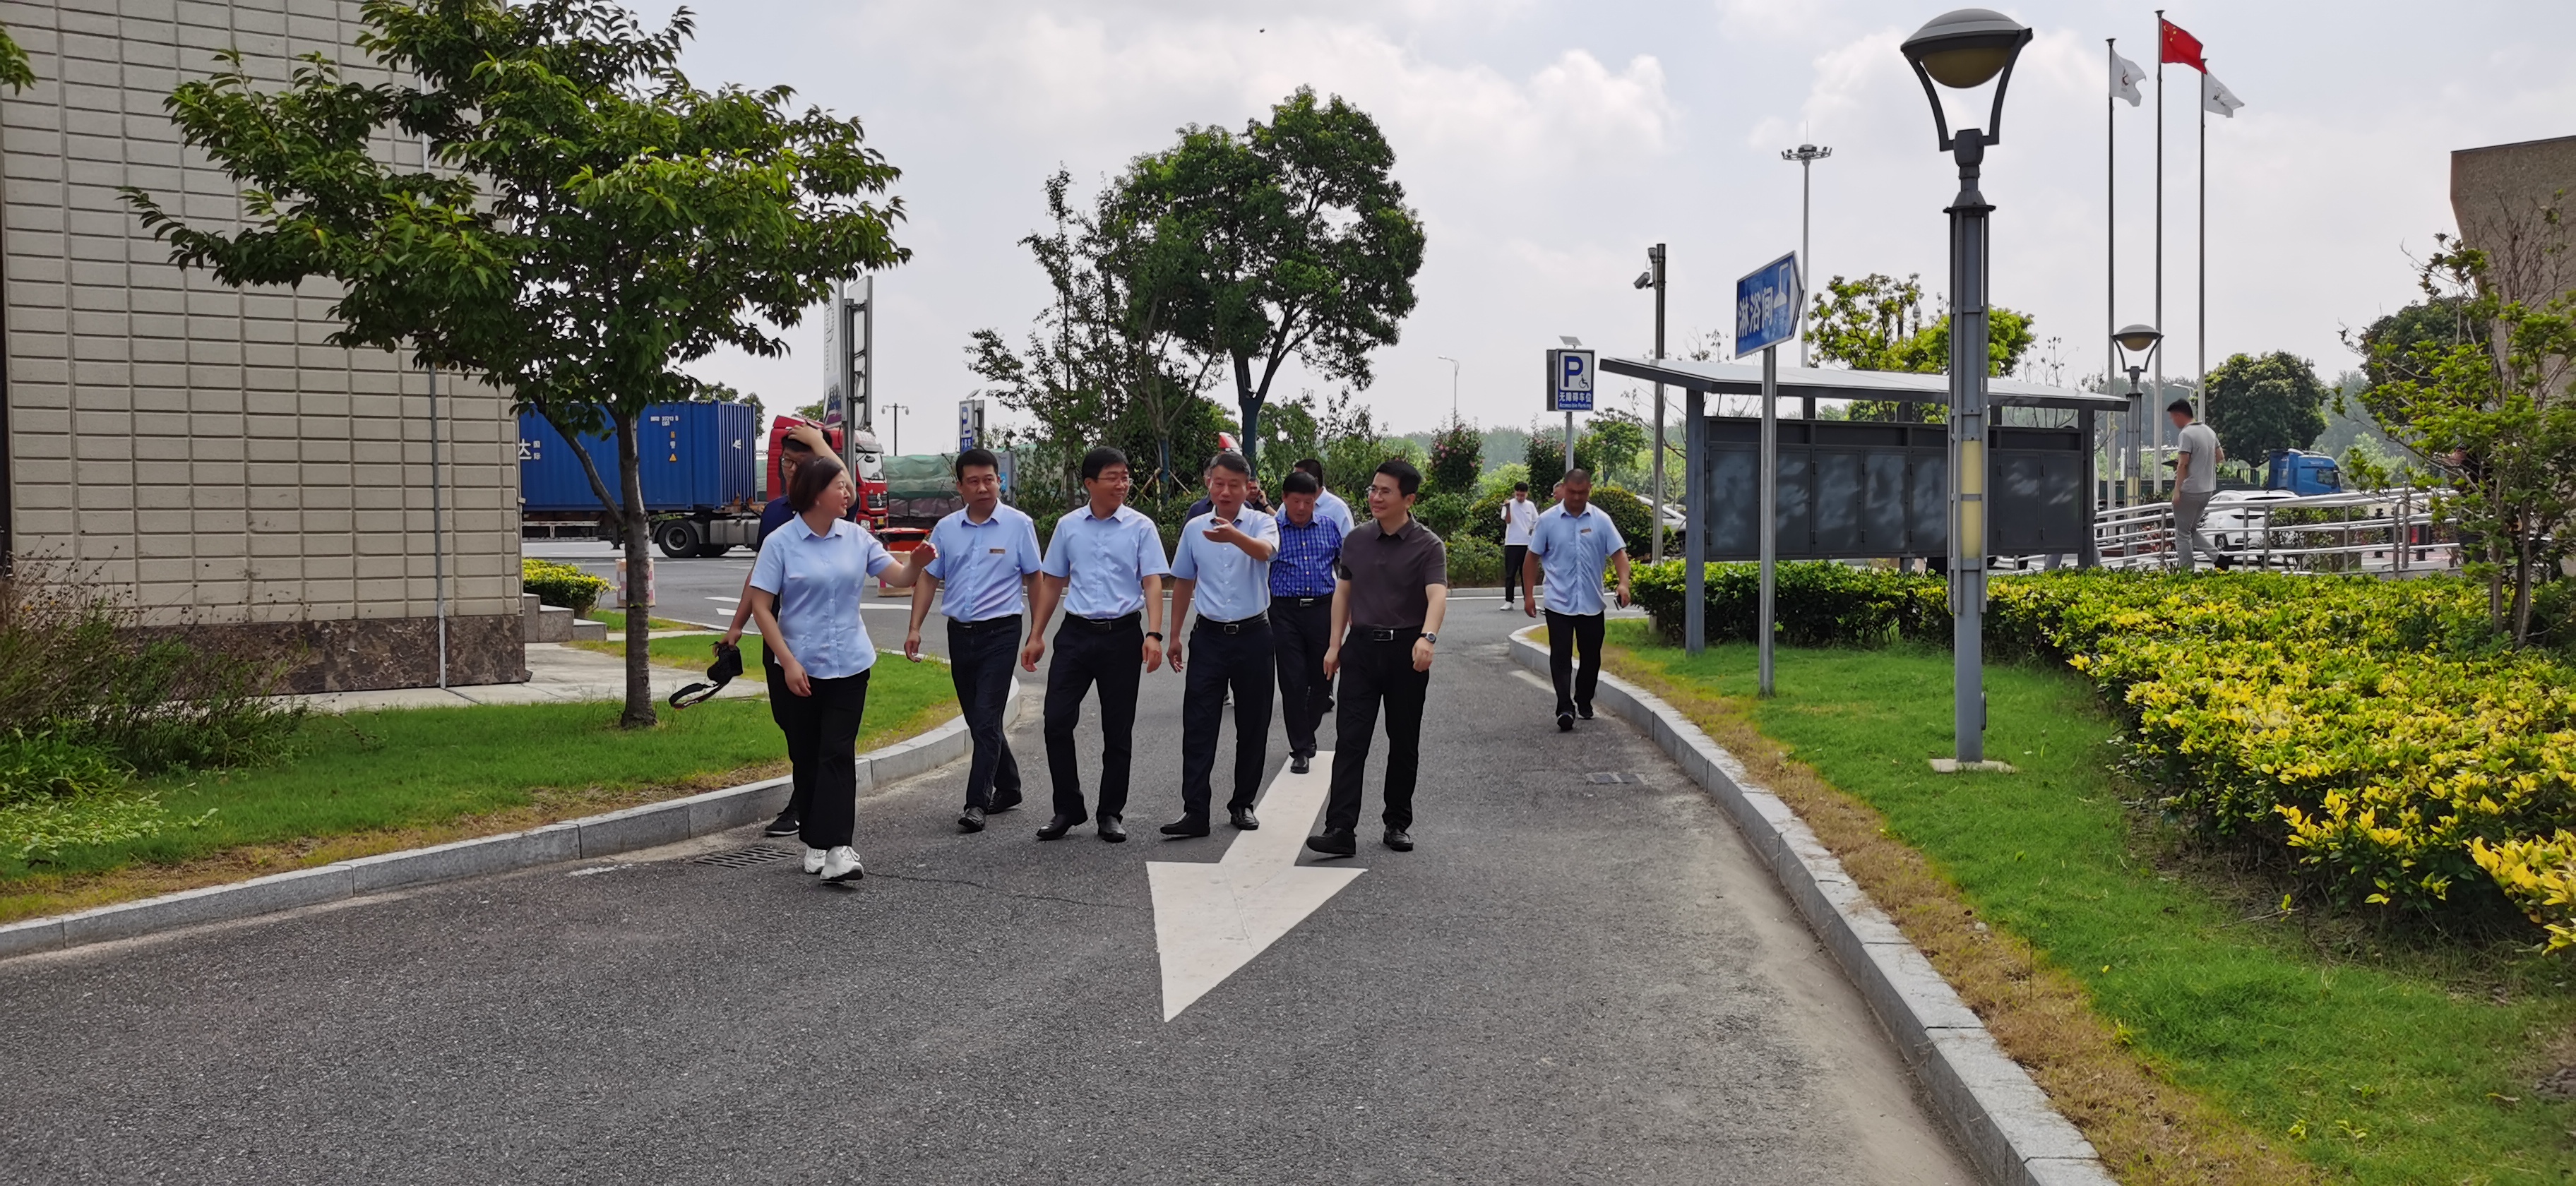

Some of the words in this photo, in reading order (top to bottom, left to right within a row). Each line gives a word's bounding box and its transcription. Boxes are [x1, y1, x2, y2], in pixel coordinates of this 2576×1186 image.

[1739, 287, 1773, 337] 淋浴间
[1564, 356, 1583, 388] P
[1559, 392, 1592, 402] 无障碍车位
